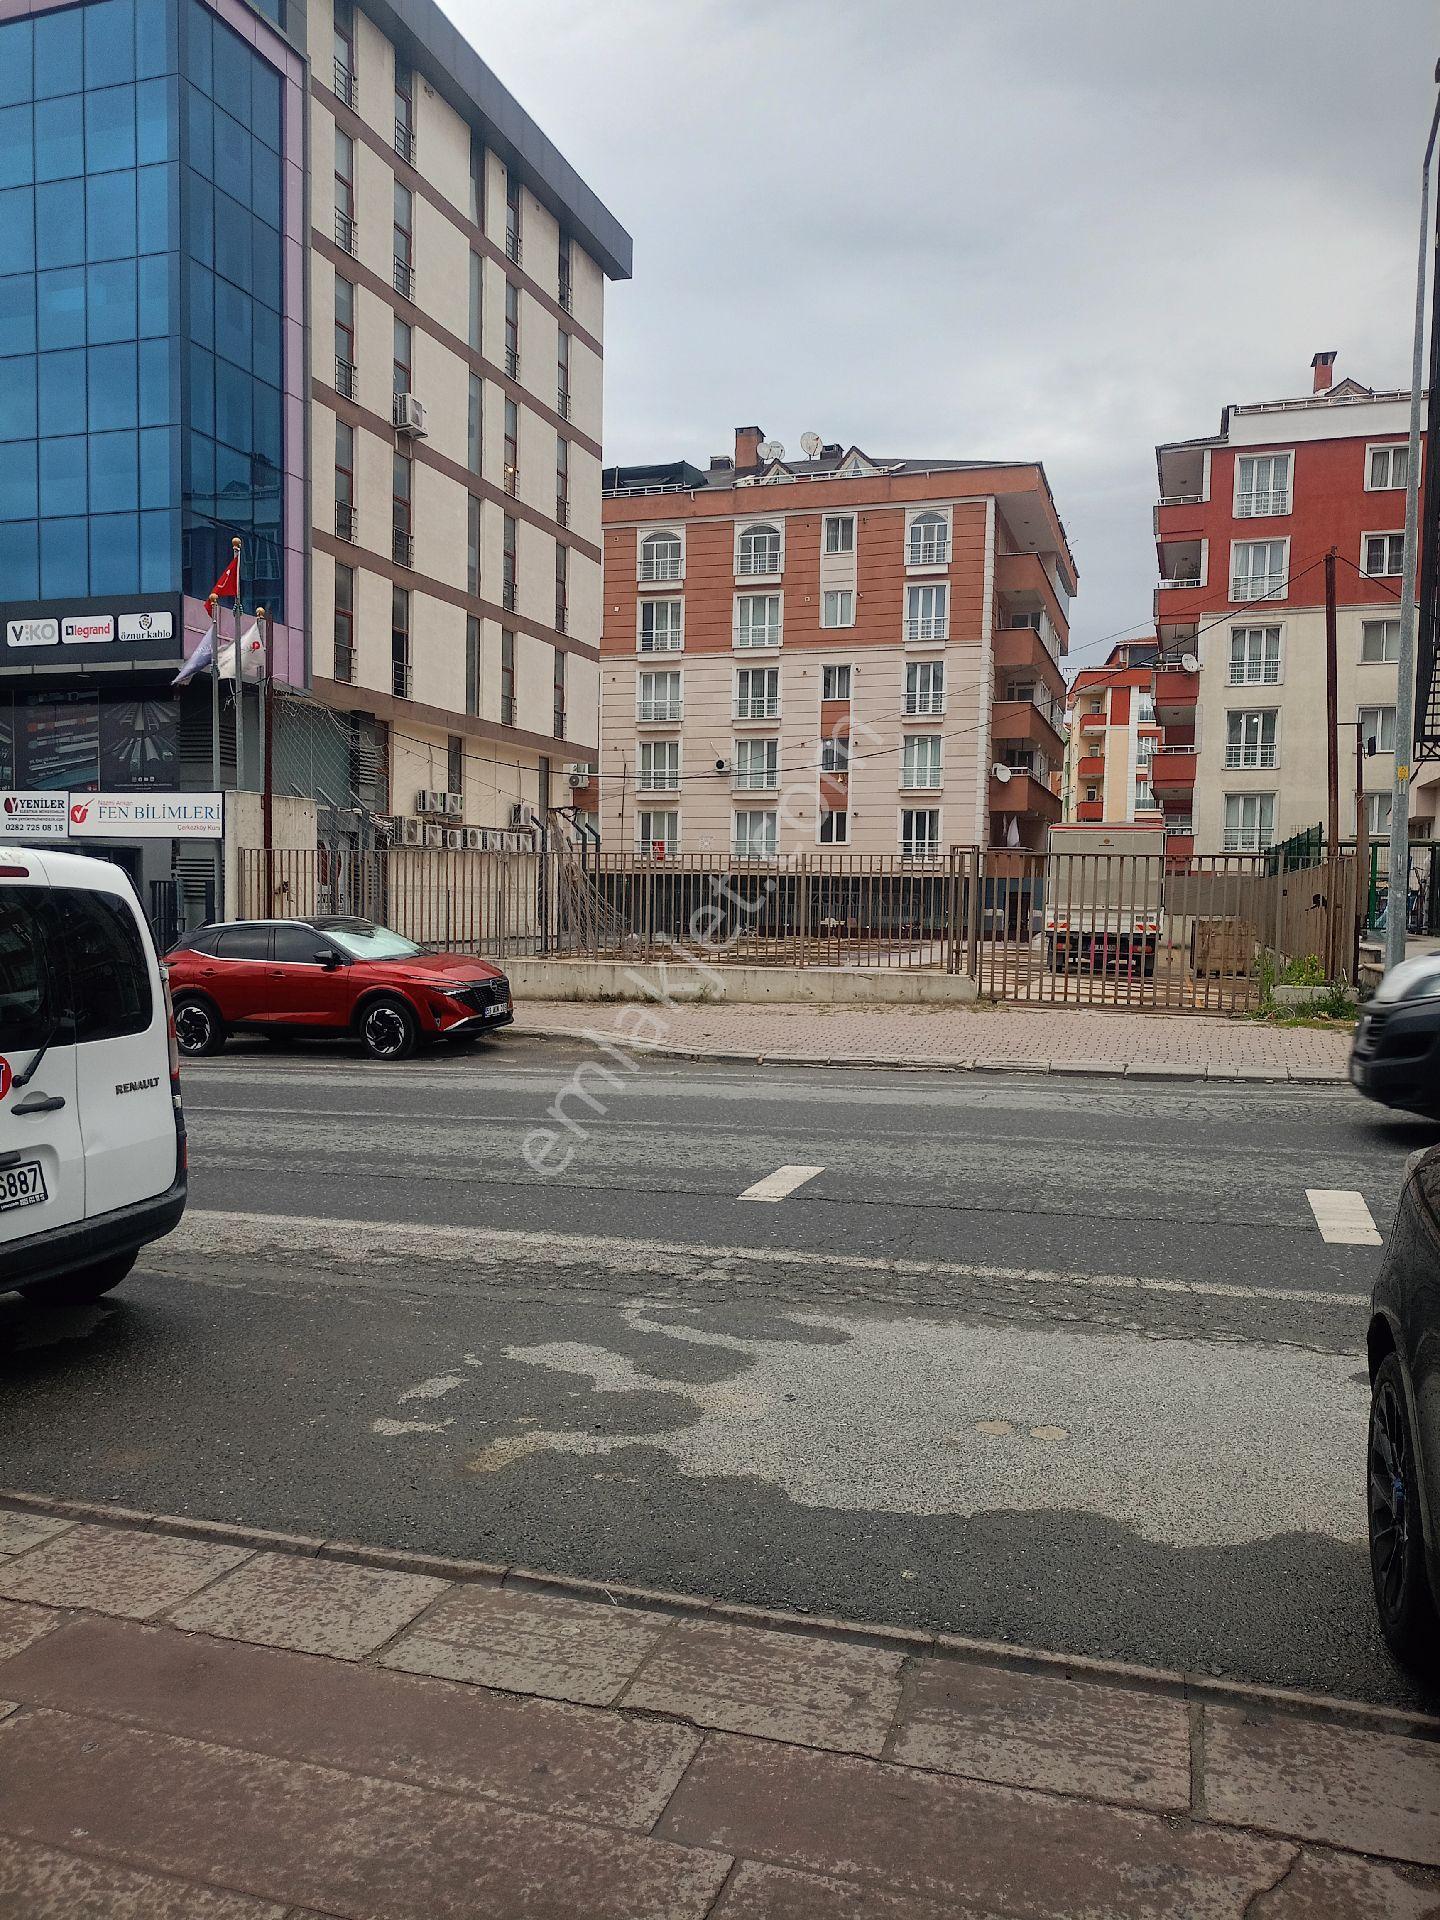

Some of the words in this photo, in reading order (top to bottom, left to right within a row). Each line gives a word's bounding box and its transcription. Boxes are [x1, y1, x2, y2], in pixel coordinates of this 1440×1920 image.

[74, 623, 110, 639] legrand
[19, 797, 65, 809] YENİLER
[99, 806, 129, 819] FEN
[135, 803, 220, 819] BİLİMLERİ
[115, 1077, 160, 1095] RENAULT
